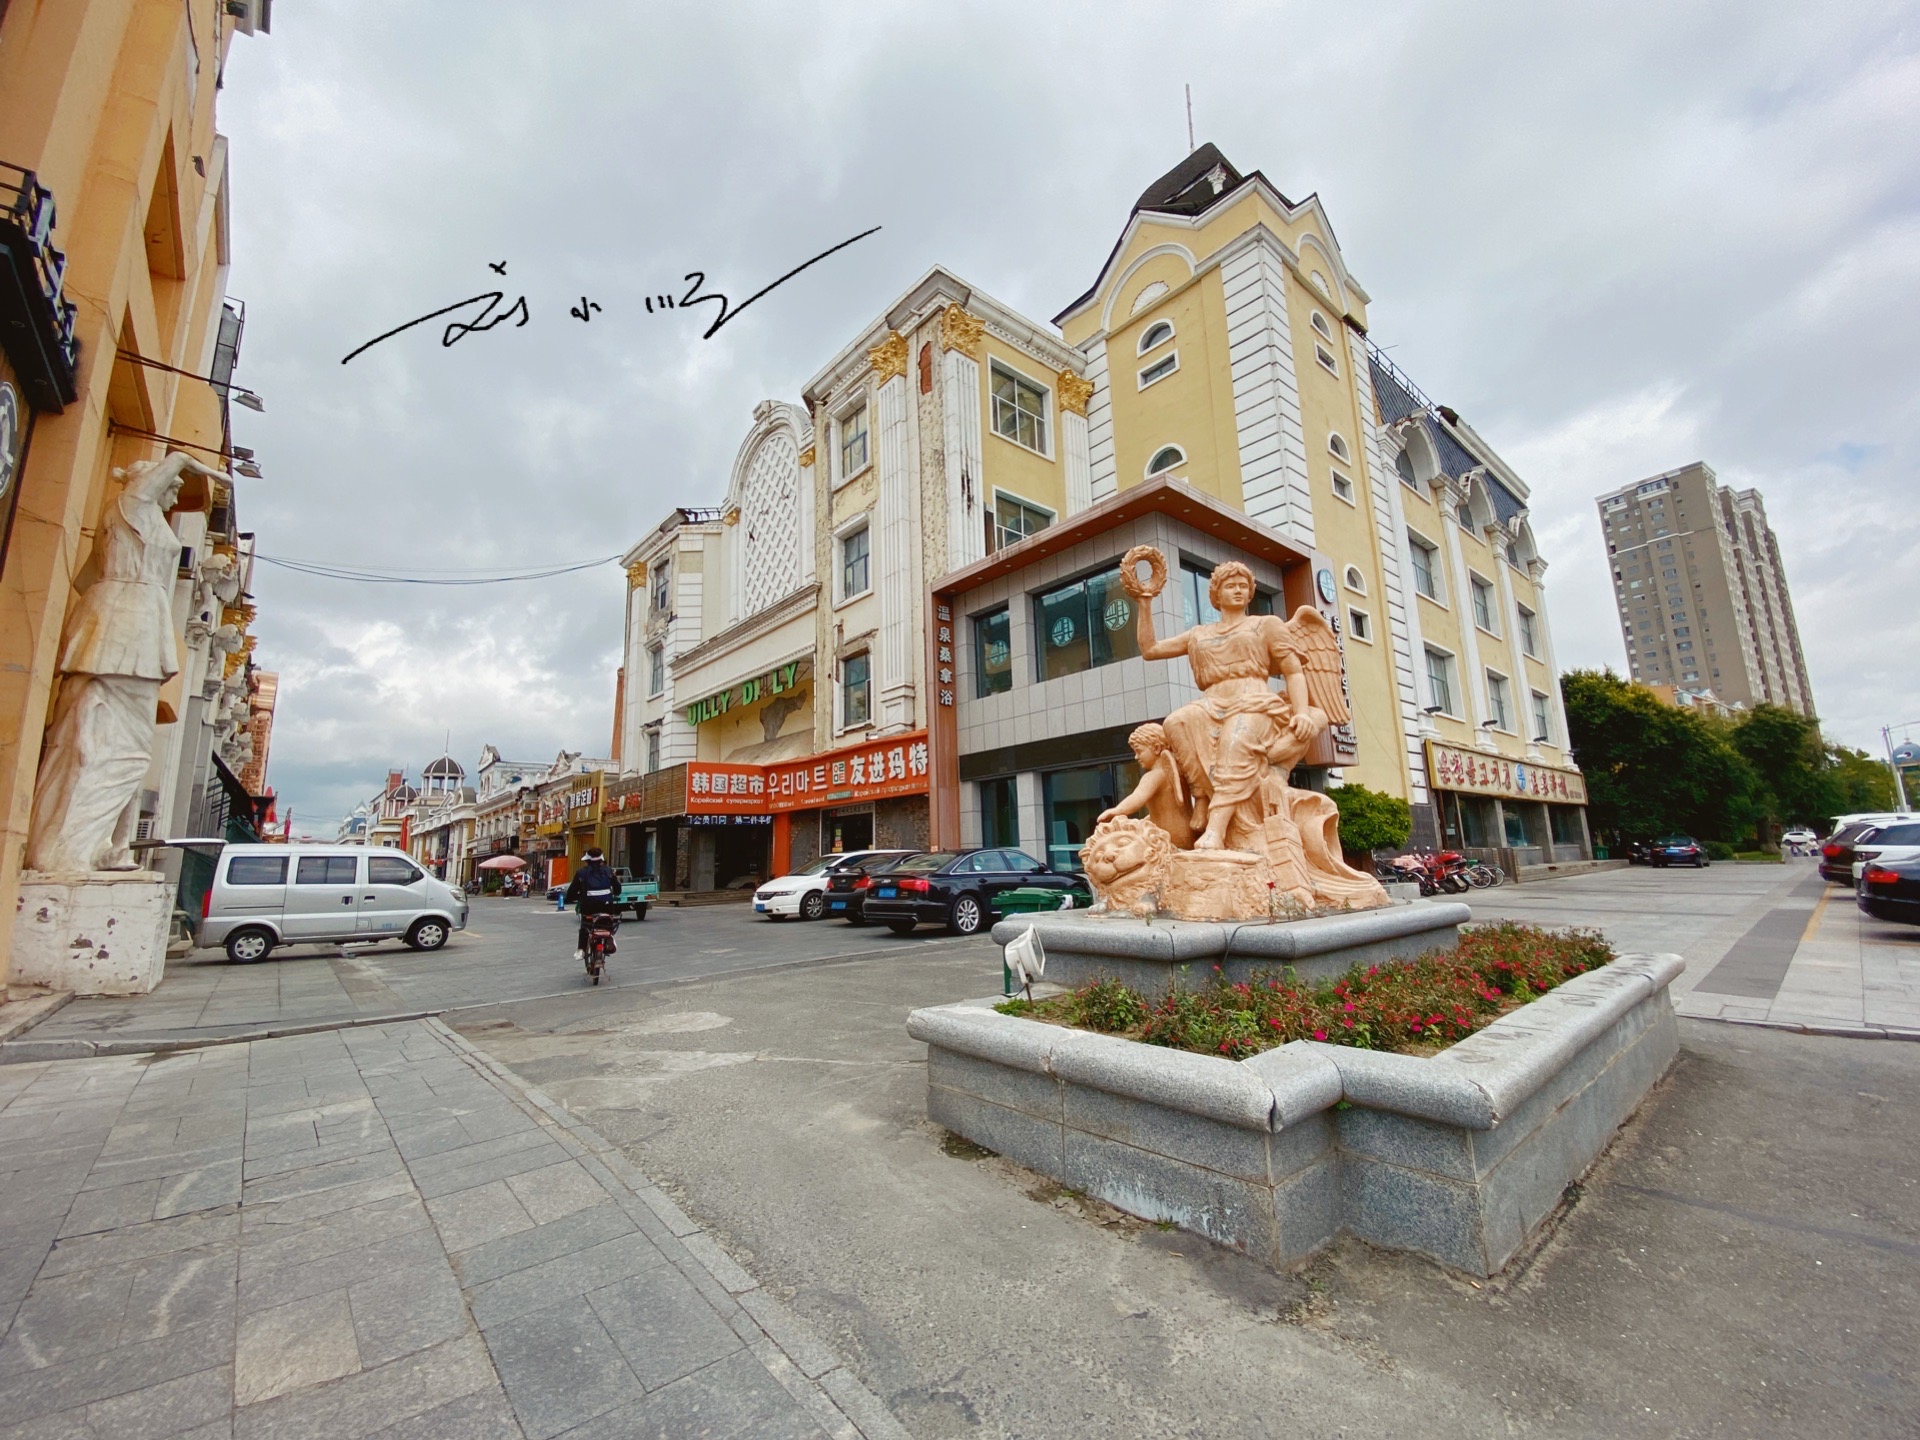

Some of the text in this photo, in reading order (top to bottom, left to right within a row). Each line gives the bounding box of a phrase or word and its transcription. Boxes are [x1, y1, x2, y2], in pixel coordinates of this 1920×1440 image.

[938, 605, 953, 706] 温泉桑拿浴
[767, 765, 828, 800] 우리마트
[850, 742, 928, 785] 友进玛特
[691, 772, 765, 795] 韩国超市
